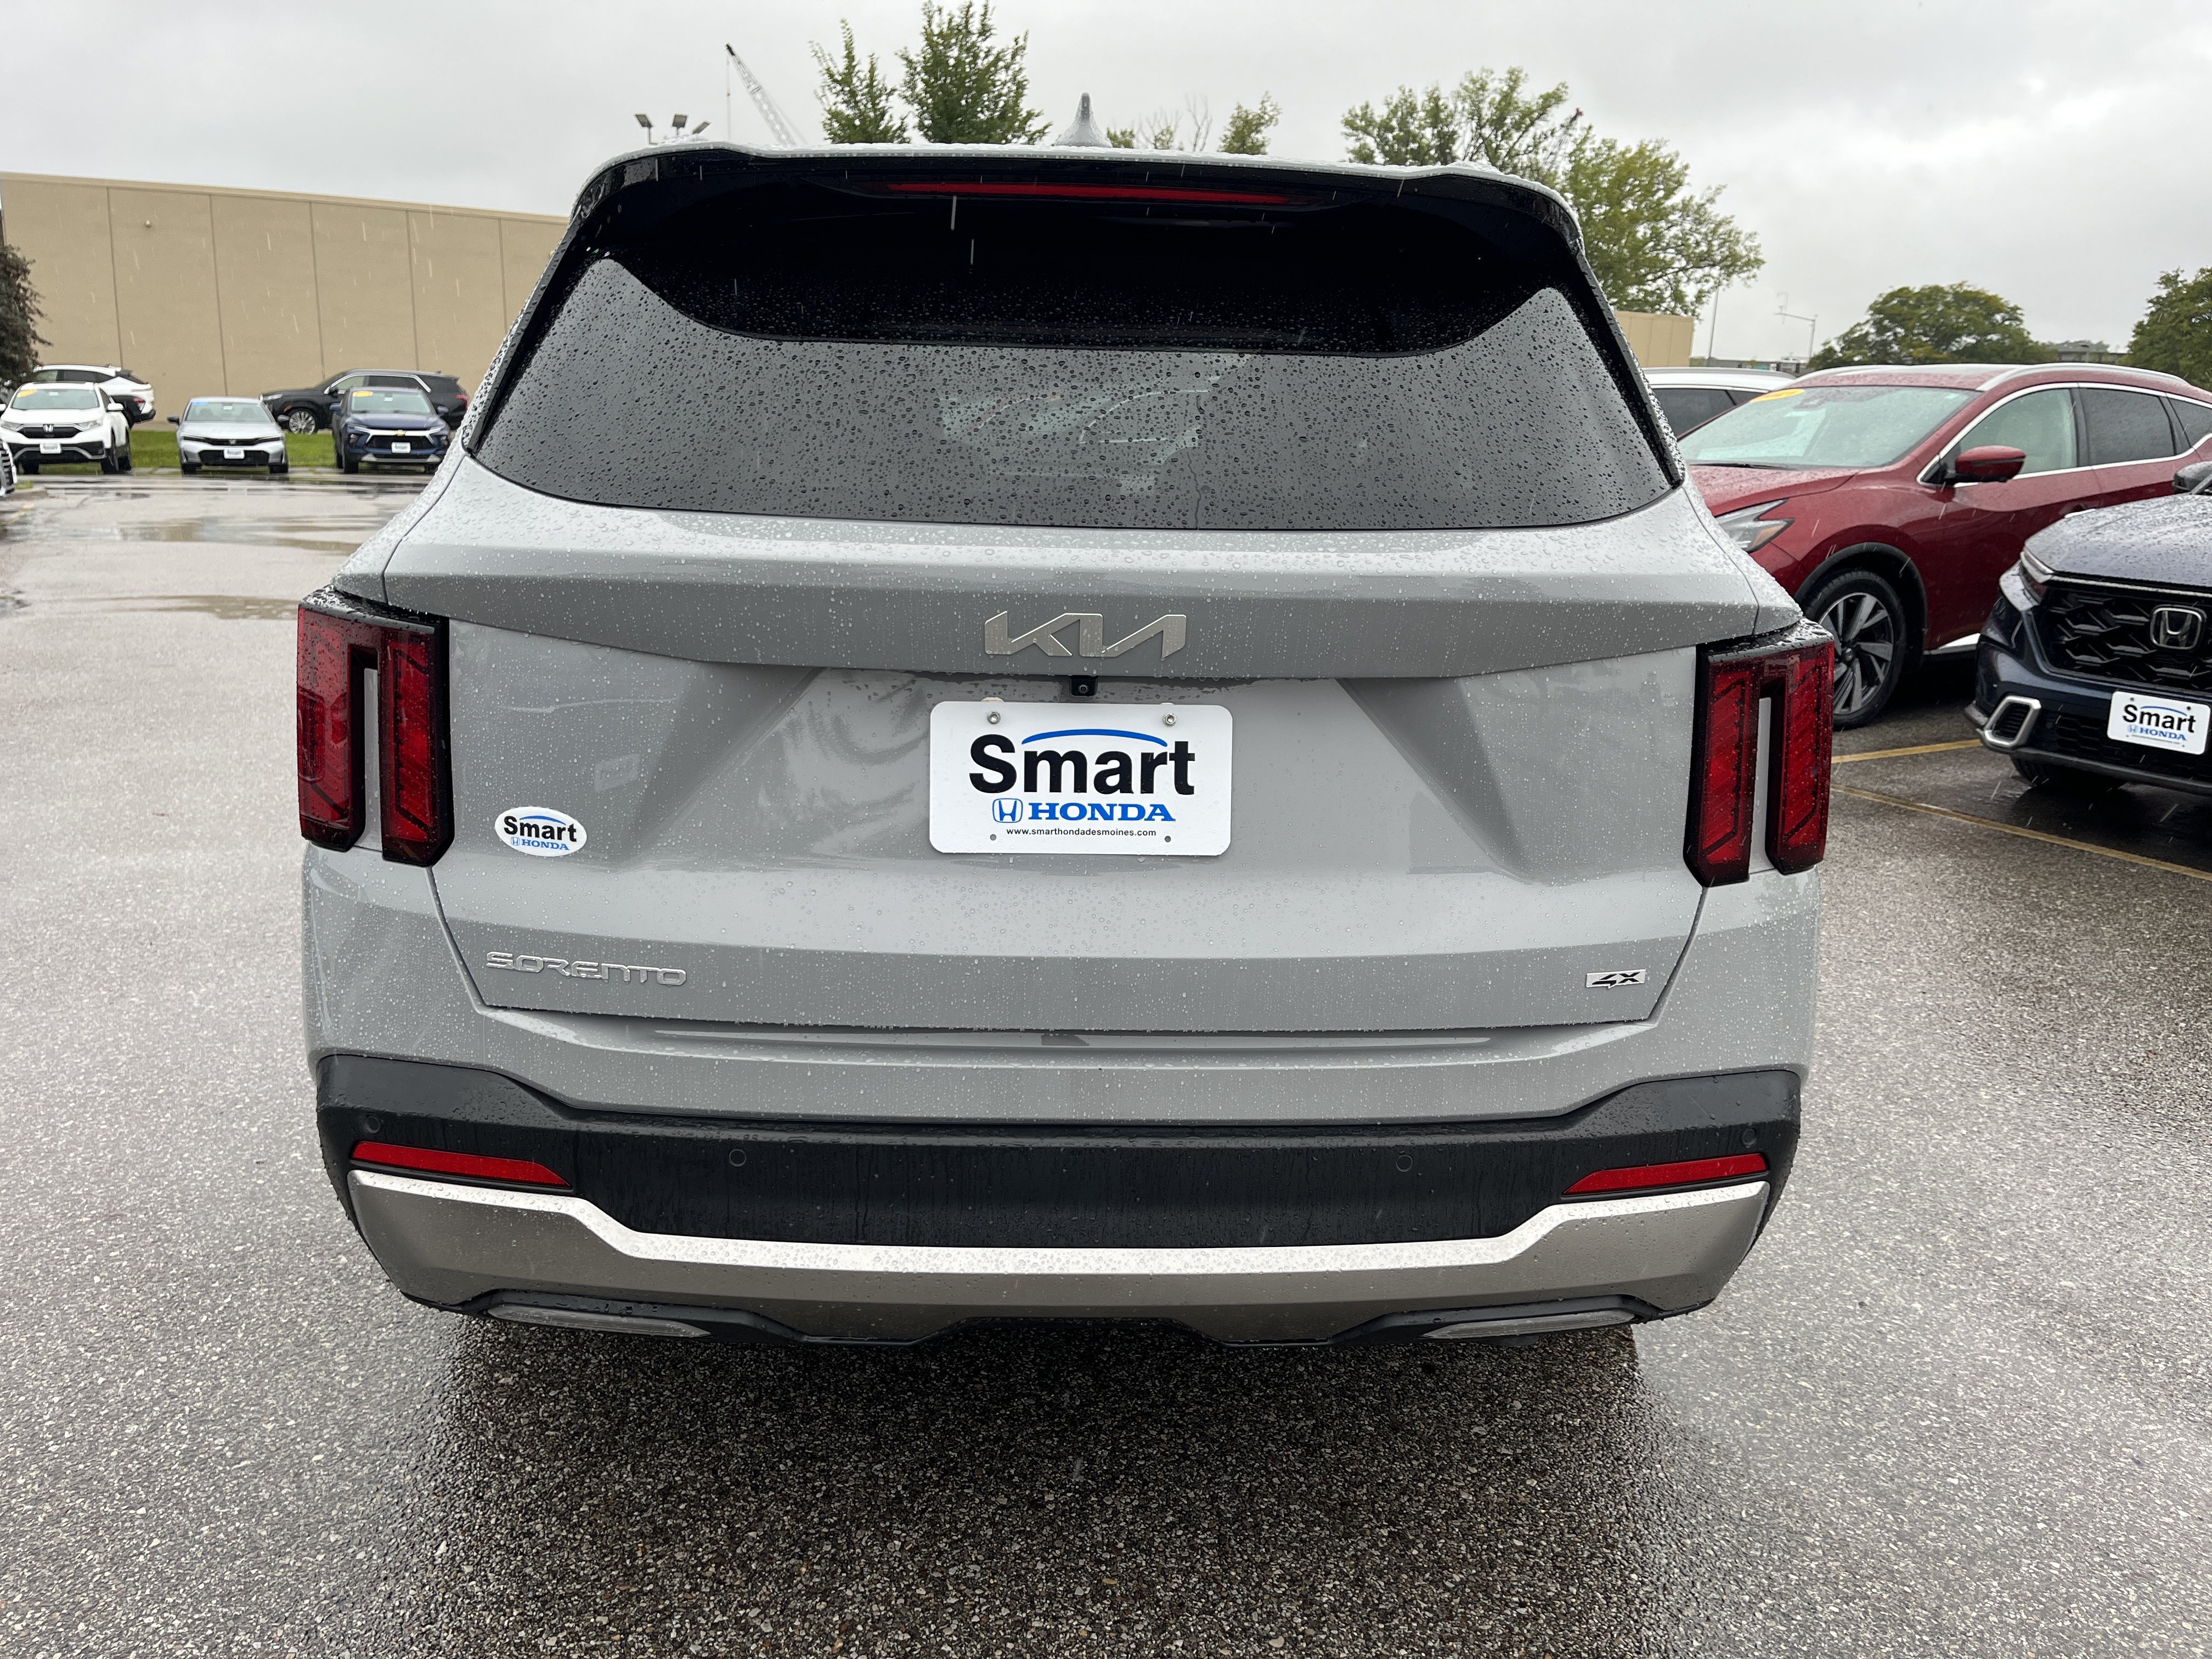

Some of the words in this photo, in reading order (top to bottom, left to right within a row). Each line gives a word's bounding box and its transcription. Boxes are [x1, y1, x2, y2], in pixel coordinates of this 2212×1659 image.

[2122, 704, 2197, 733] Smart
[2140, 727, 2187, 741] HONDA
[969, 734, 1195, 795] Smart
[1028, 802, 1176, 822] HONDA
[504, 815, 577, 842] Smart
[1006, 827, 1156, 837] www.smarthondadesmoines.com
[521, 839, 570, 850] HONDA
[486, 951, 687, 986] SORENTO
